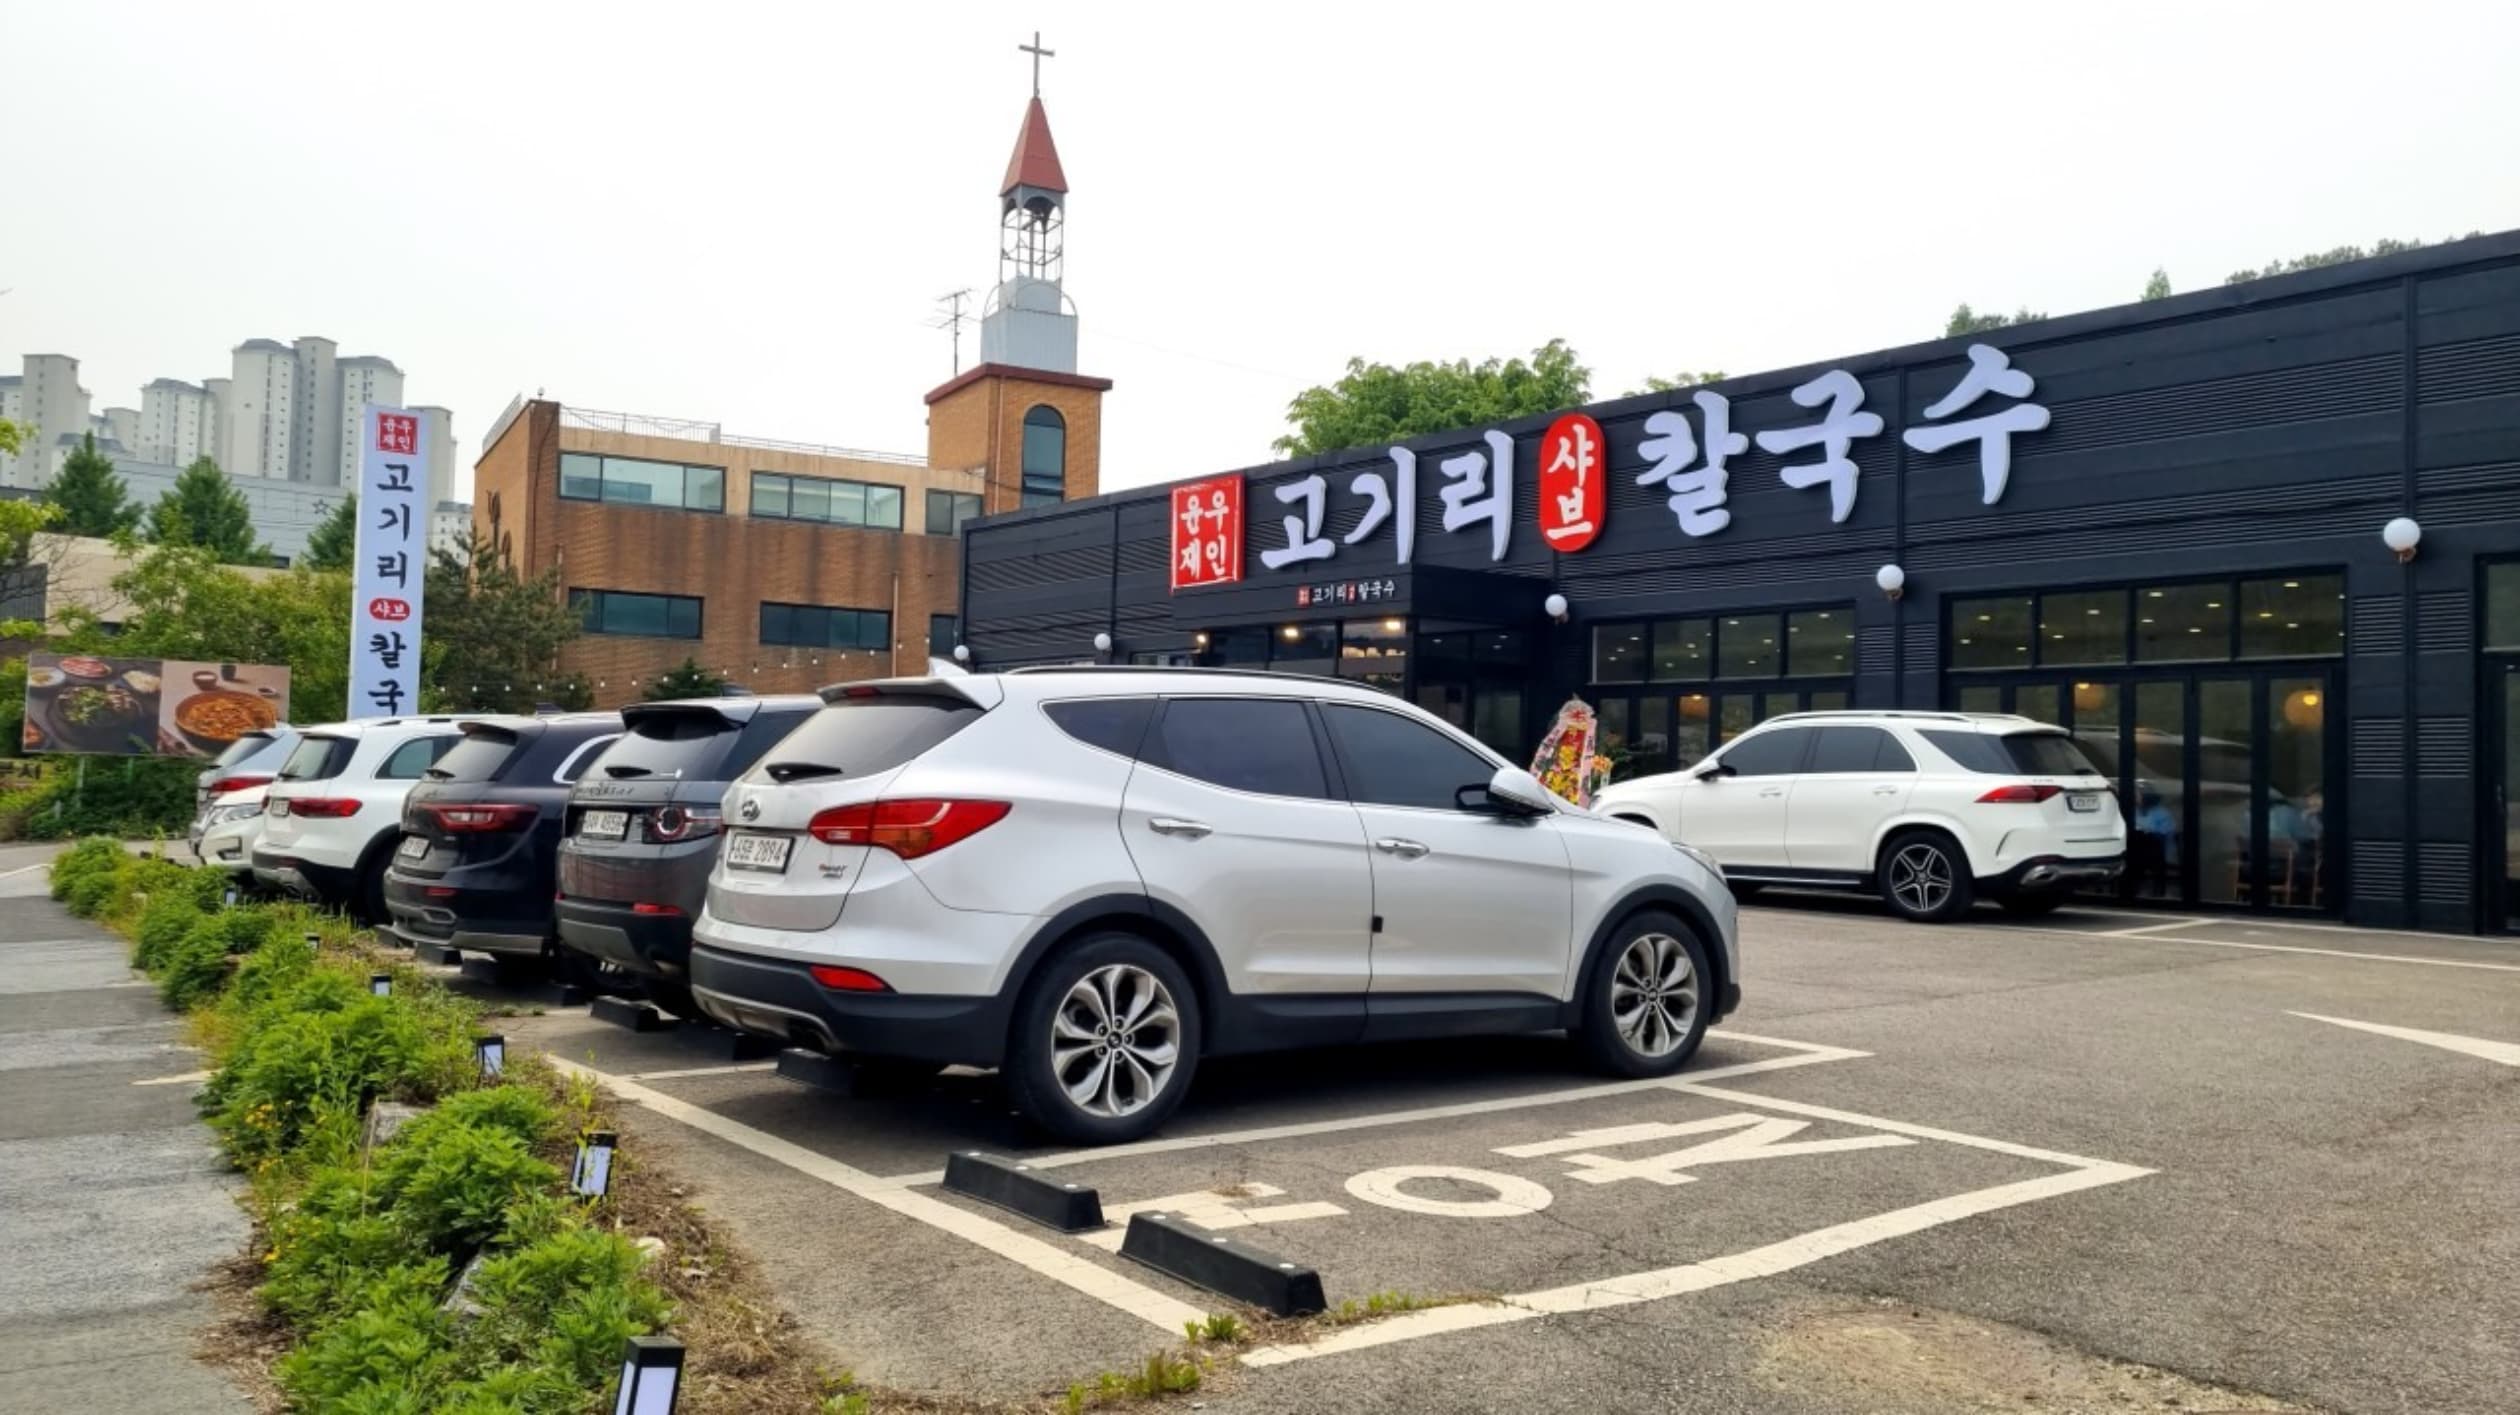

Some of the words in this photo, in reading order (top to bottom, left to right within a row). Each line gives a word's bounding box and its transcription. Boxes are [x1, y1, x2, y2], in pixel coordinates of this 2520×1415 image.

[1259, 428, 1515, 569] 고기리
[1547, 423, 1595, 540] 샤브
[1636, 343, 2051, 537] 칼국수
[376, 464, 414, 588] 고기리
[374, 602, 407, 619] 샤브
